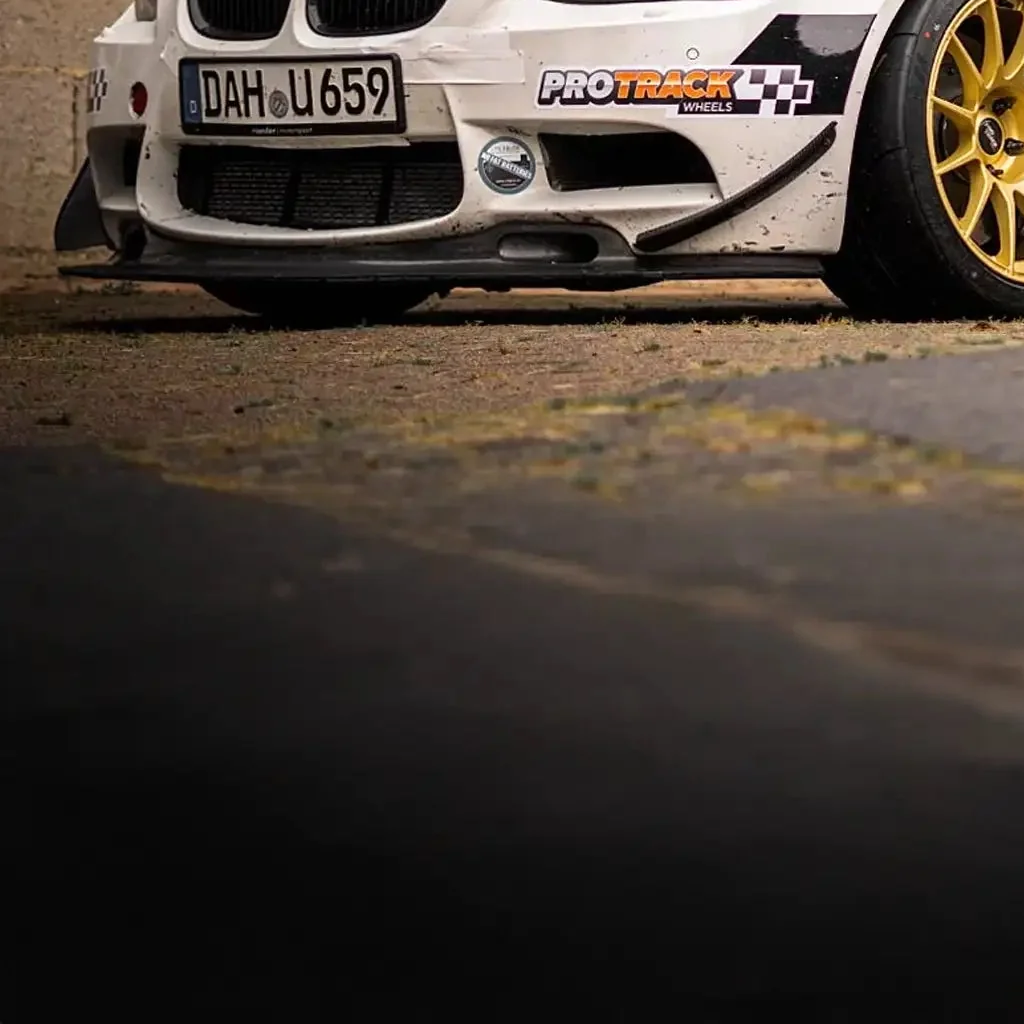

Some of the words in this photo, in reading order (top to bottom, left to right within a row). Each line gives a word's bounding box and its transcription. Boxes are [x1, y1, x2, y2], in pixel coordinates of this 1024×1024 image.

[202, 69, 266, 117] DAH
[540, 70, 738, 101] PROTRACK
[682, 101, 733, 113] WHEELS
